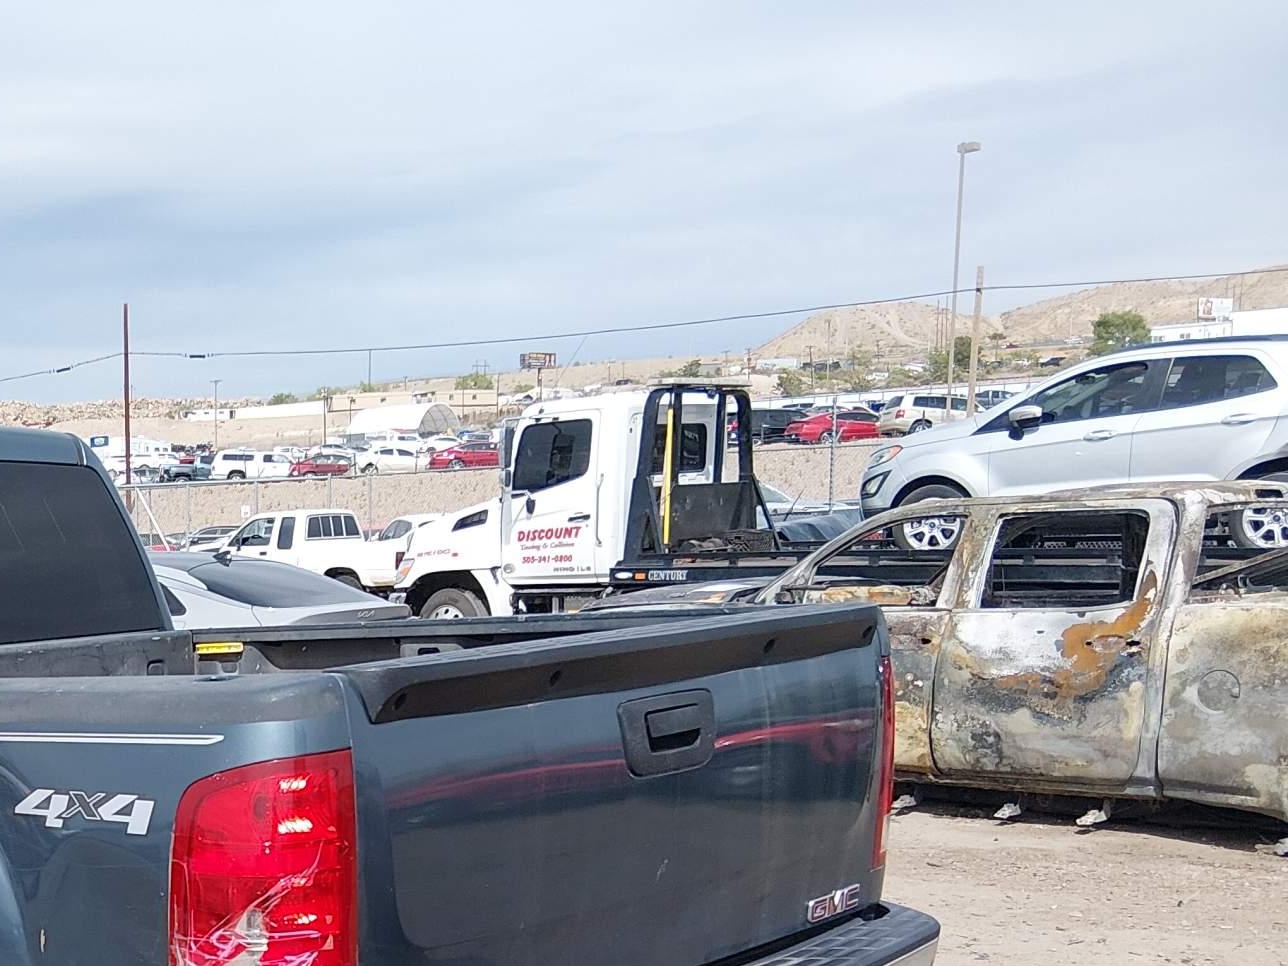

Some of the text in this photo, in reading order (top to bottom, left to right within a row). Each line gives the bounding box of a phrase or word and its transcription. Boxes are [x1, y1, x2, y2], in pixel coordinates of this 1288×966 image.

[517, 526, 582, 542] DISCOUNT
[648, 570, 688, 581] CENTURY
[808, 883, 860, 923] GMC
